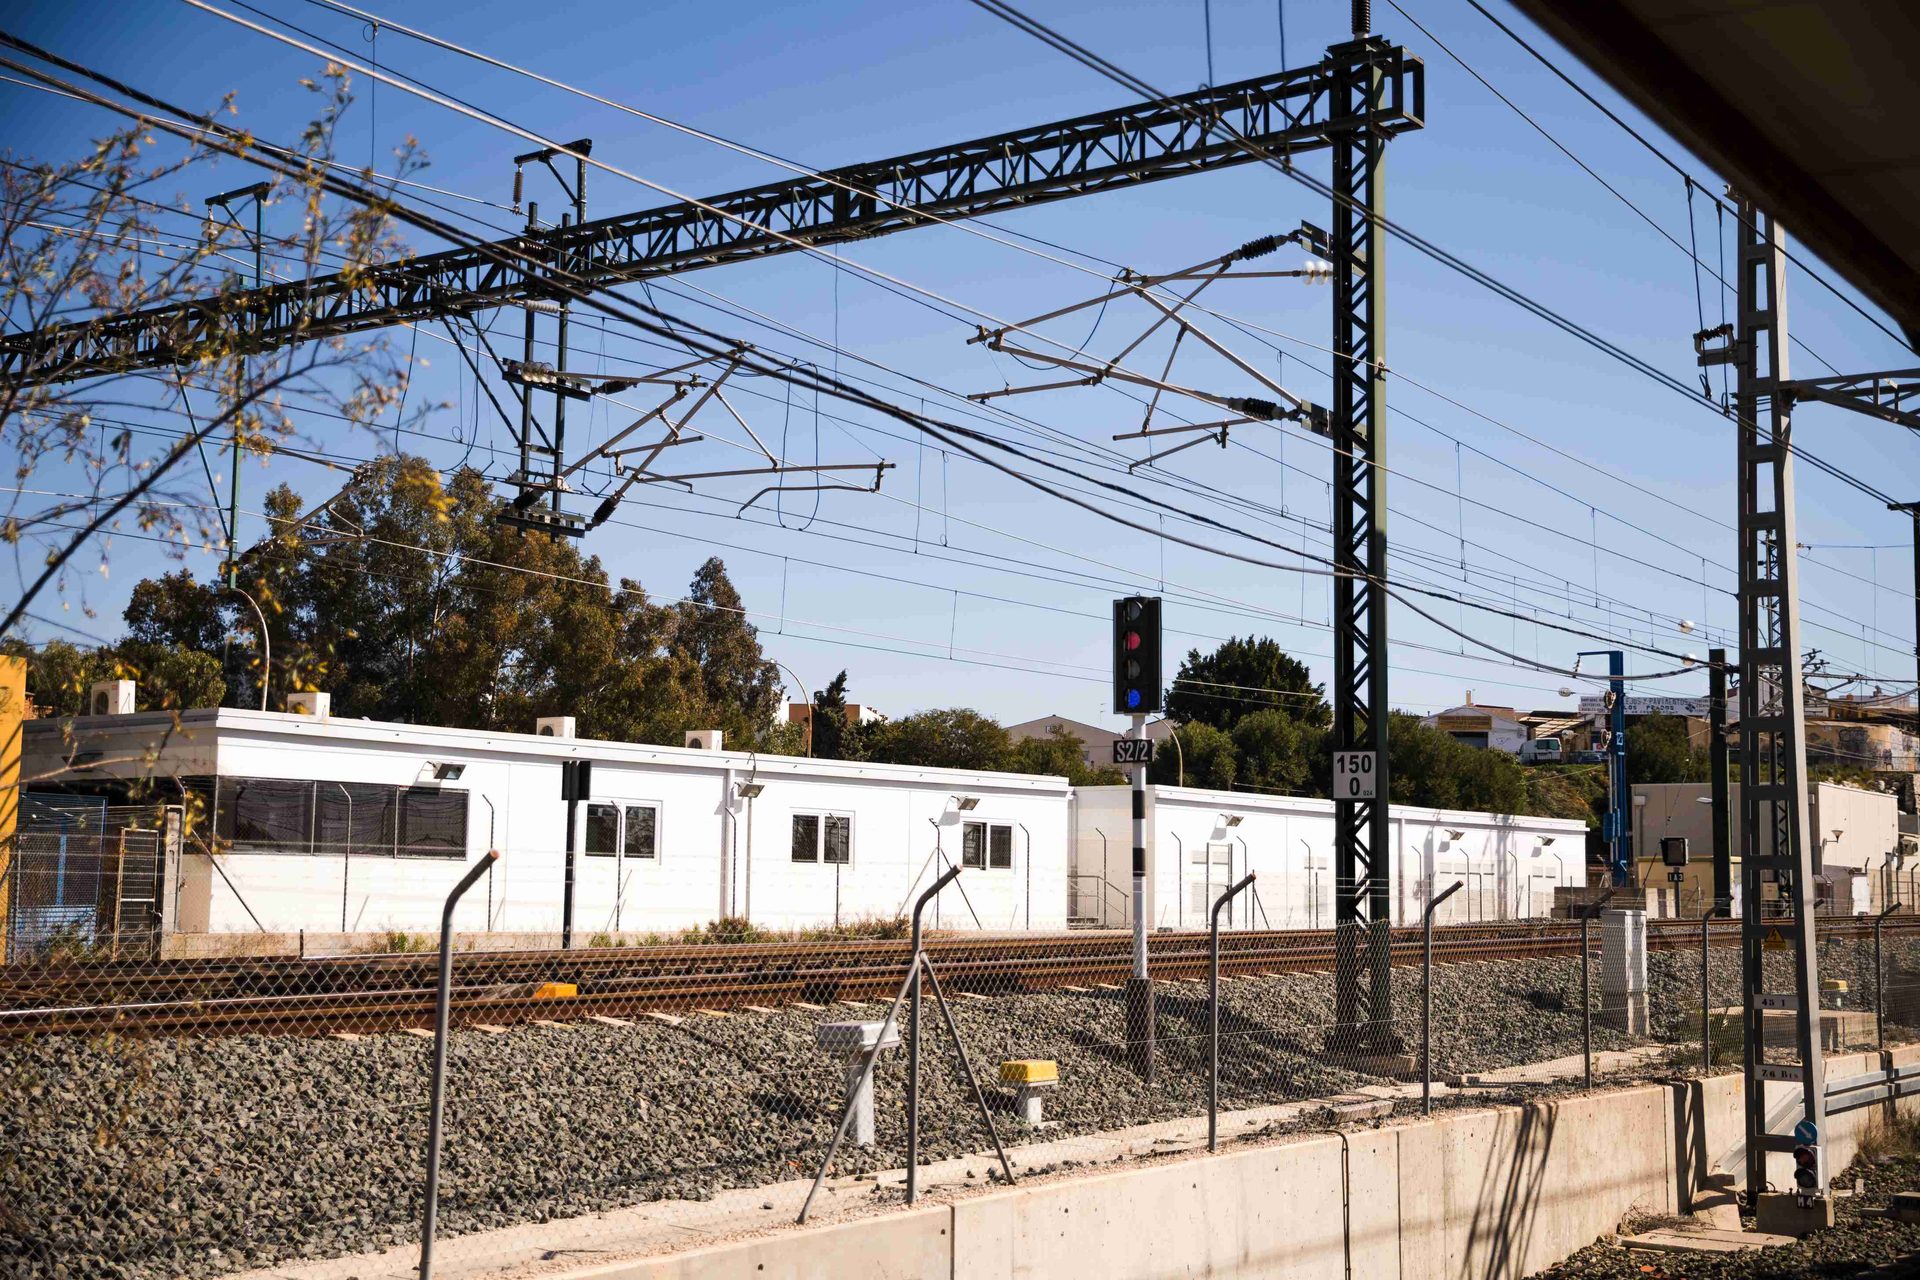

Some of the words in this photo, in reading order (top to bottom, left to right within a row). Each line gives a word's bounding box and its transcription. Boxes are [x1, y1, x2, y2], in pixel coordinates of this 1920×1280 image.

[1116, 741, 1148, 762] S2/2
[1337, 754, 1372, 774] 150
[1349, 777, 1360, 796] 0
